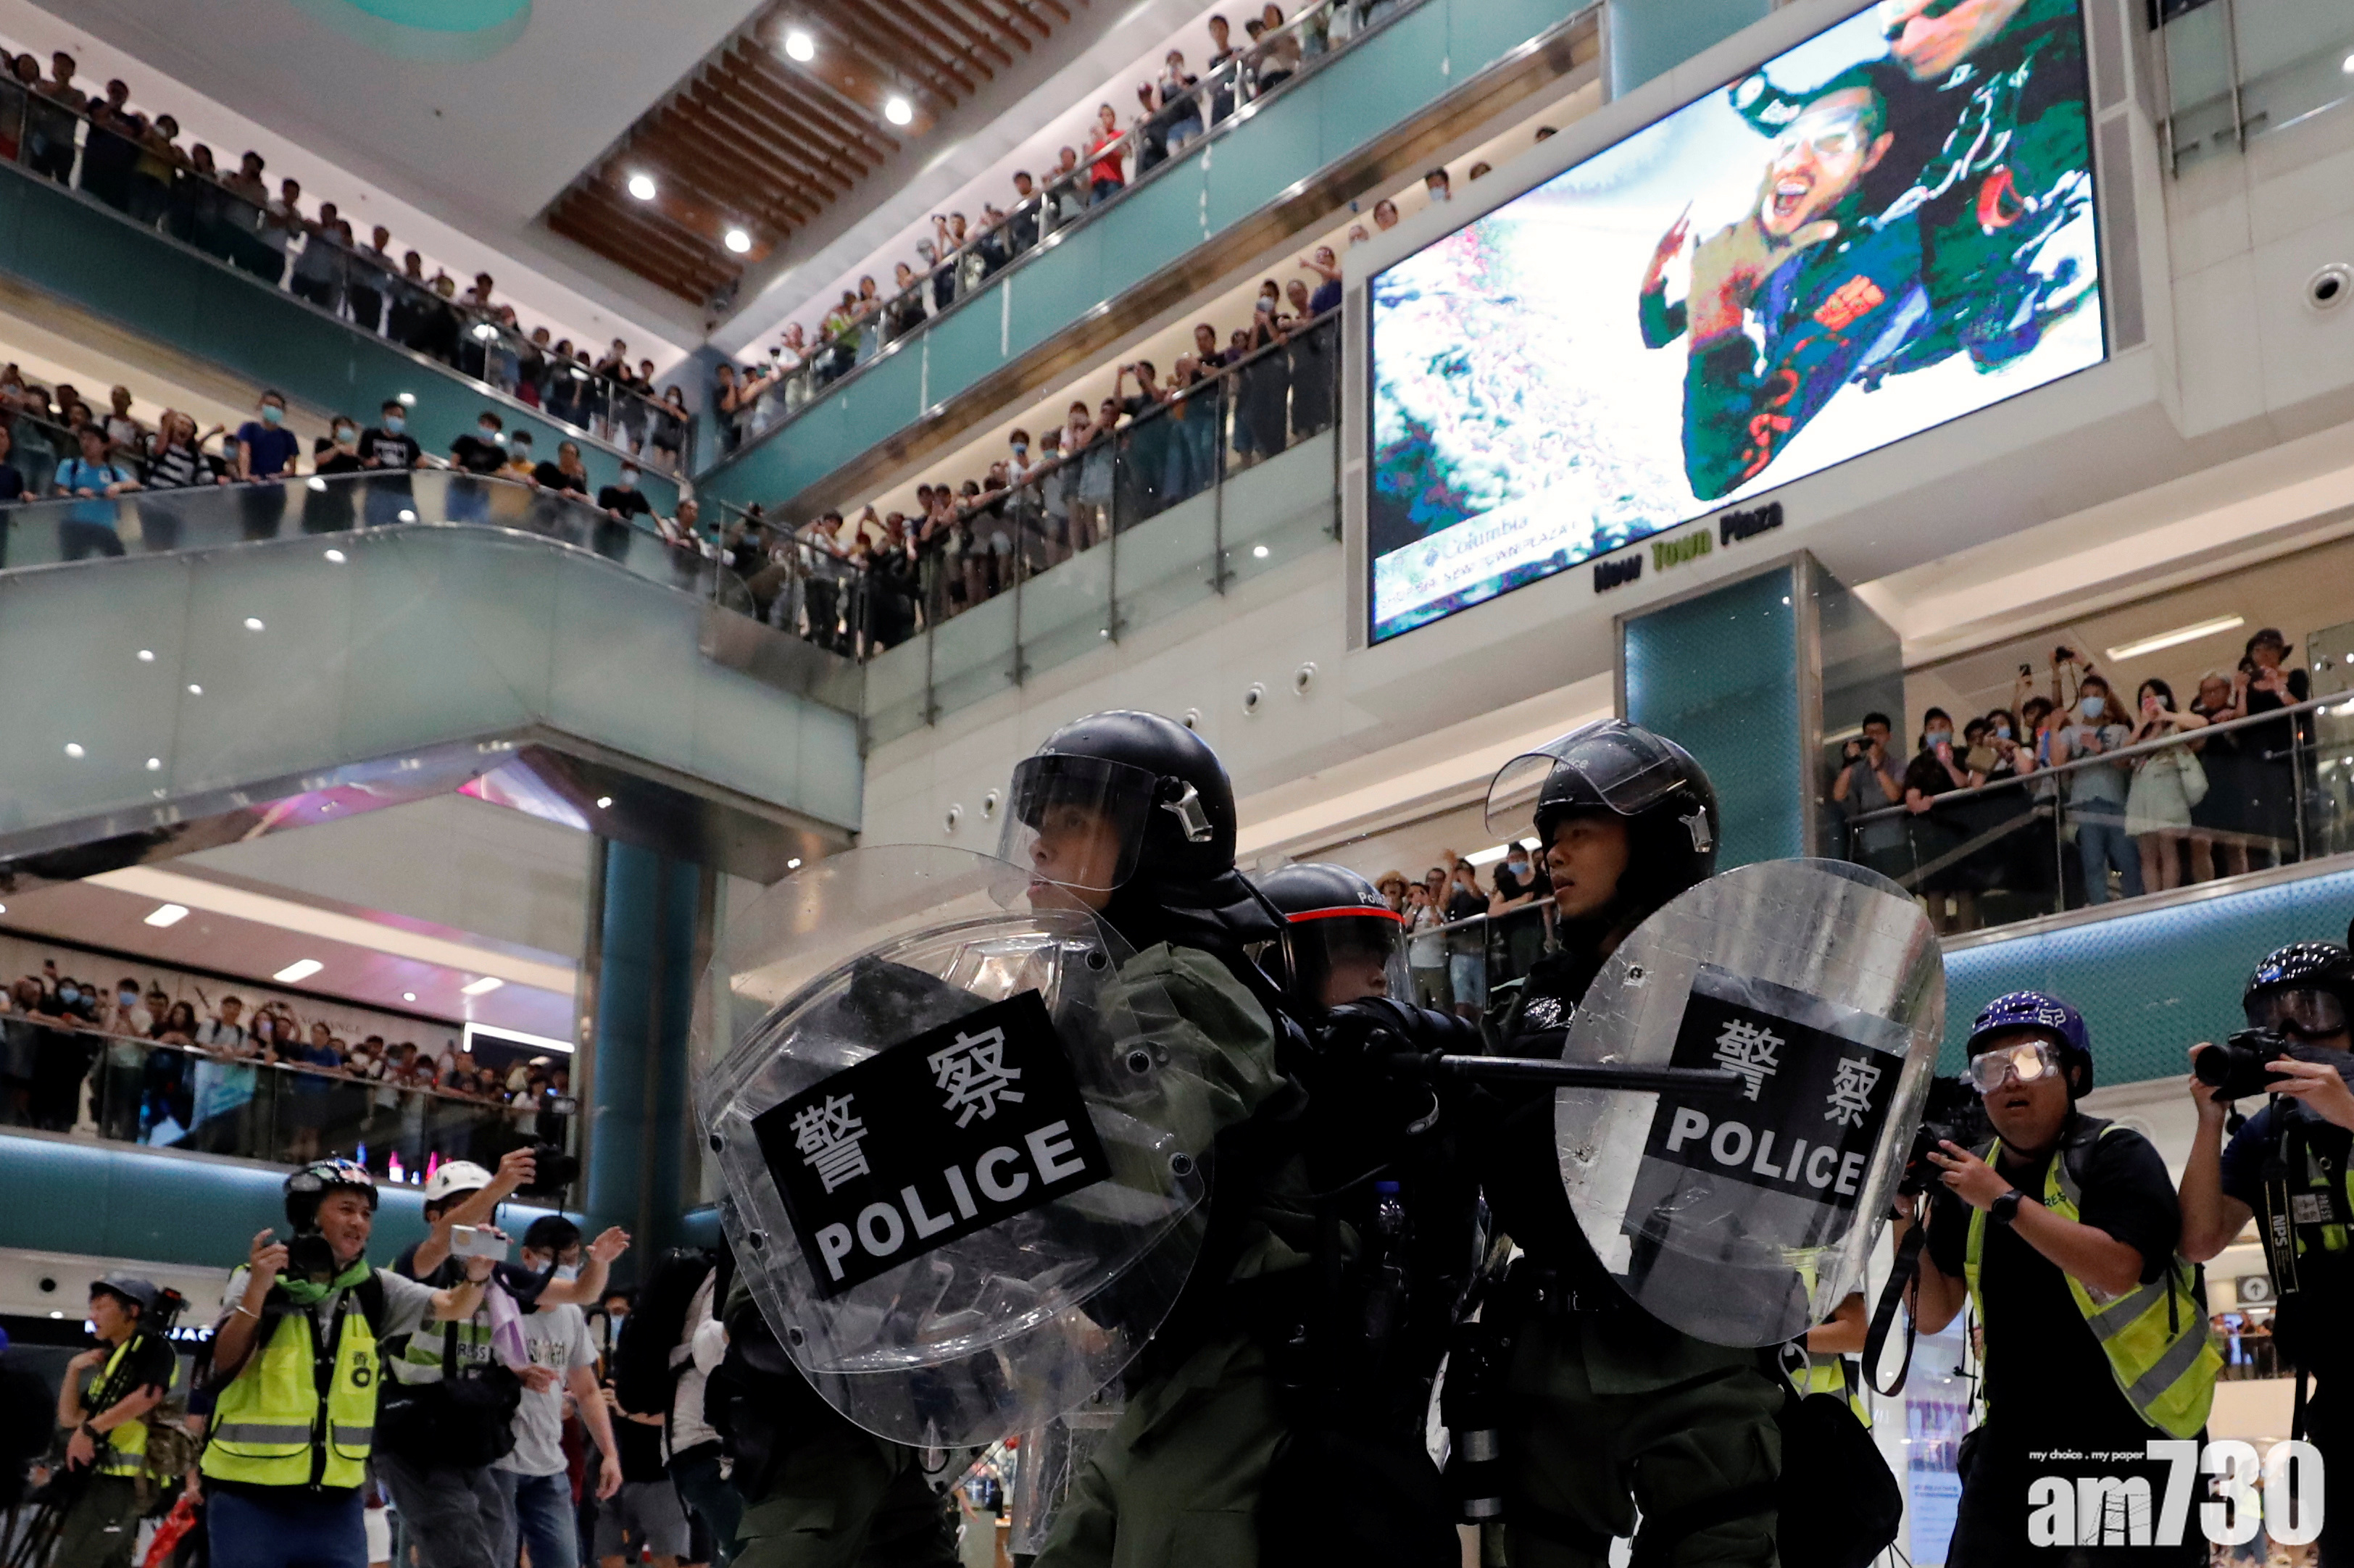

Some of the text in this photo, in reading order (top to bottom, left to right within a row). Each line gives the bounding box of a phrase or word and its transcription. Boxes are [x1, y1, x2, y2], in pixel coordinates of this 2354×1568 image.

[1442, 515, 1529, 559] Columbia
[1594, 500, 1784, 593] New Town Plaza
[789, 1025, 1026, 1195] 警察
[1711, 1018, 1881, 1128] 警察
[1665, 1106, 1865, 1196] POLICE
[815, 1119, 1086, 1282] POLICE
[2272, 1214, 2288, 1247] NPS
